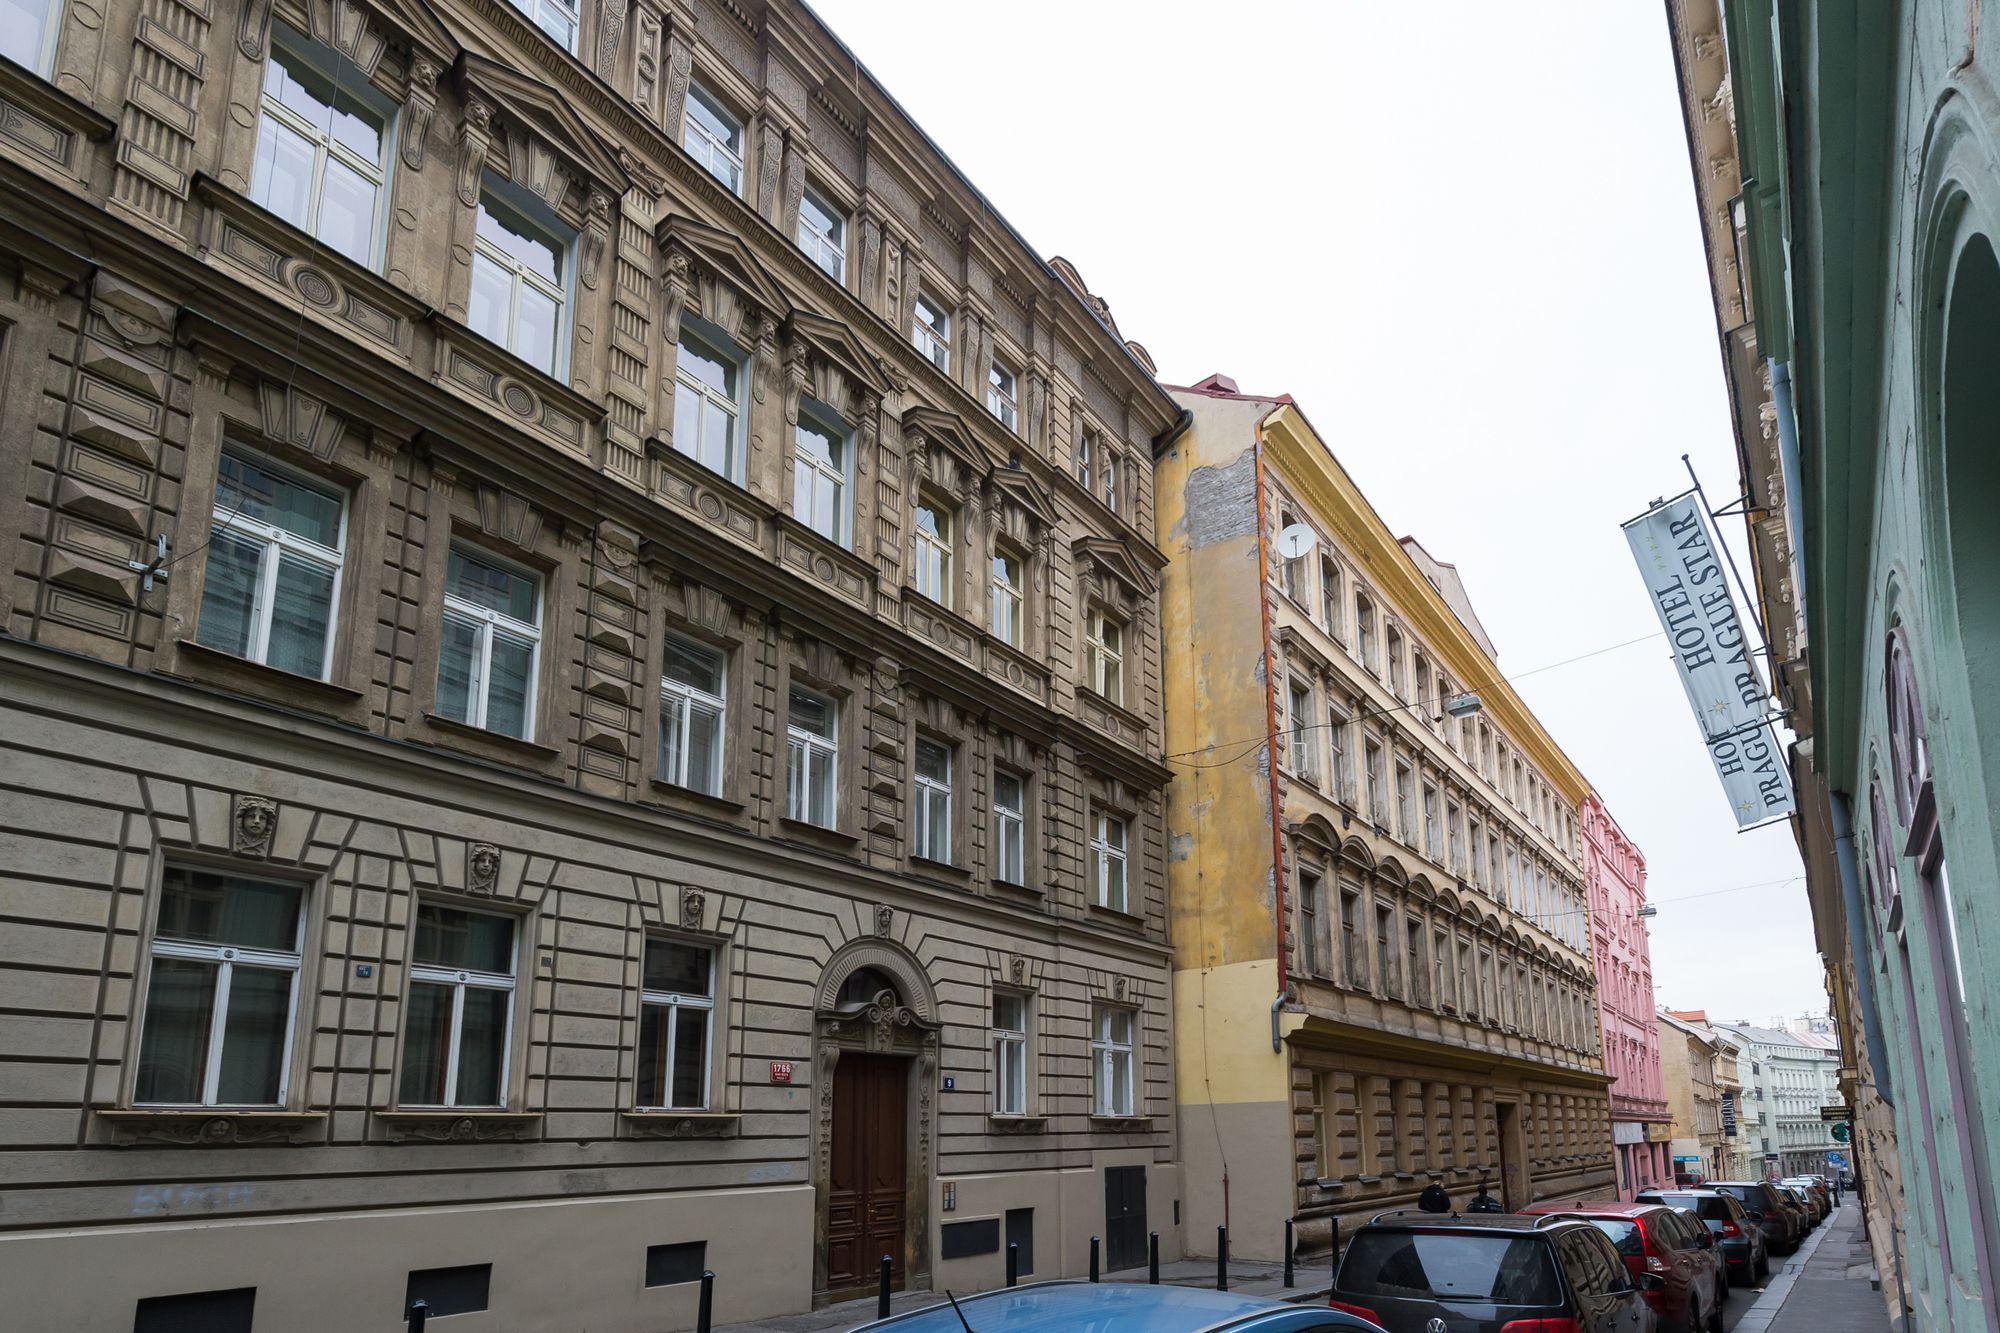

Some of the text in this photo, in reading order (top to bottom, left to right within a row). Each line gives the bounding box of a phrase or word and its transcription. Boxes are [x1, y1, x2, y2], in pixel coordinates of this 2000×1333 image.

[1656, 574, 1717, 673] HOTEL
[1669, 509, 1768, 708] PRAGUE STAR
[947, 1079, 952, 1087] 9
